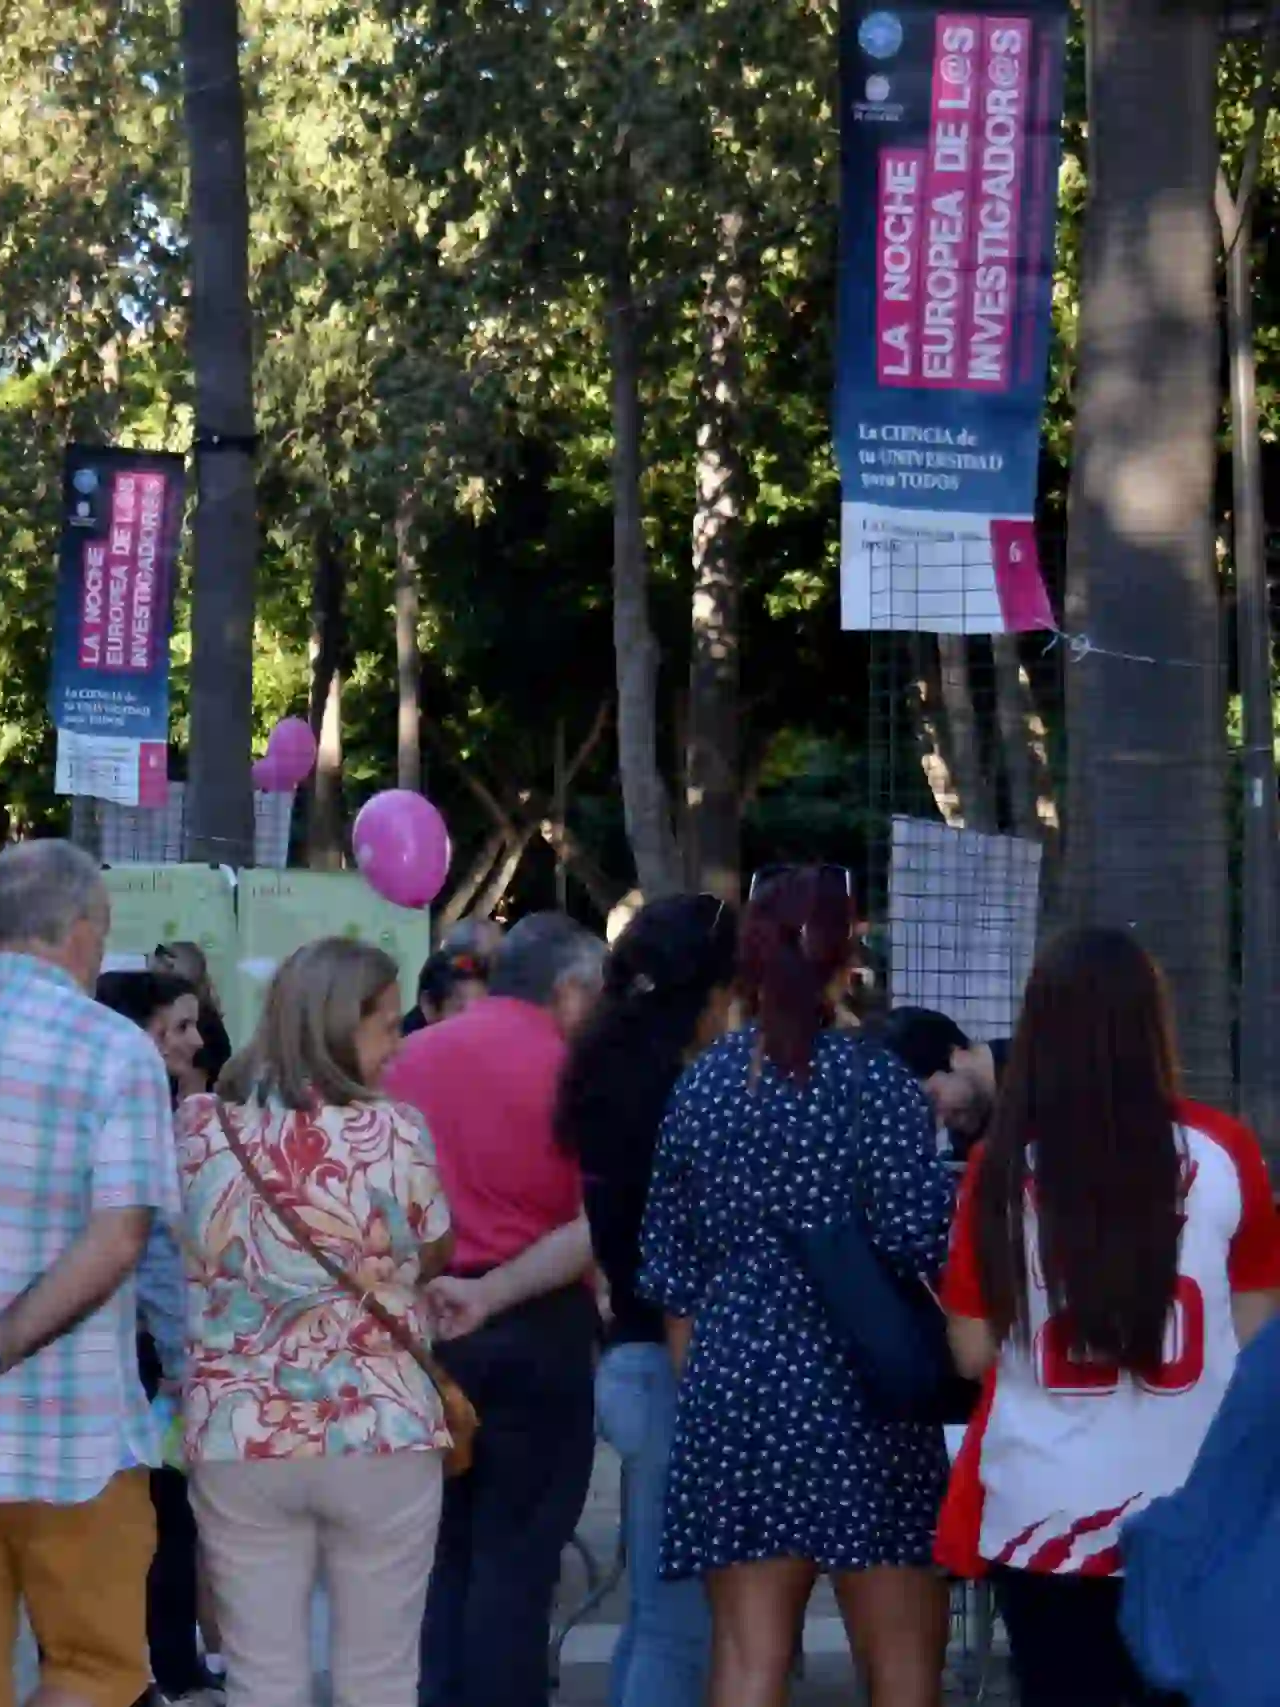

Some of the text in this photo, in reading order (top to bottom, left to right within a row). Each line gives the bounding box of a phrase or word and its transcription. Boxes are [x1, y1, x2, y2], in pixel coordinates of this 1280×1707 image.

[922, 26, 975, 378] EUROPEA DE L@S
[967, 29, 1021, 381] INVESTIGADOR@S
[881, 159, 918, 377] LA NOCHE
[879, 449, 1004, 473] UNIVERSIDAD
[881, 425, 955, 445] CIENCIA
[897, 471, 960, 491] TODOS
[111, 529, 132, 556] DE
[82, 547, 105, 664] LA NOCHE
[106, 565, 131, 665] EUROPEA
